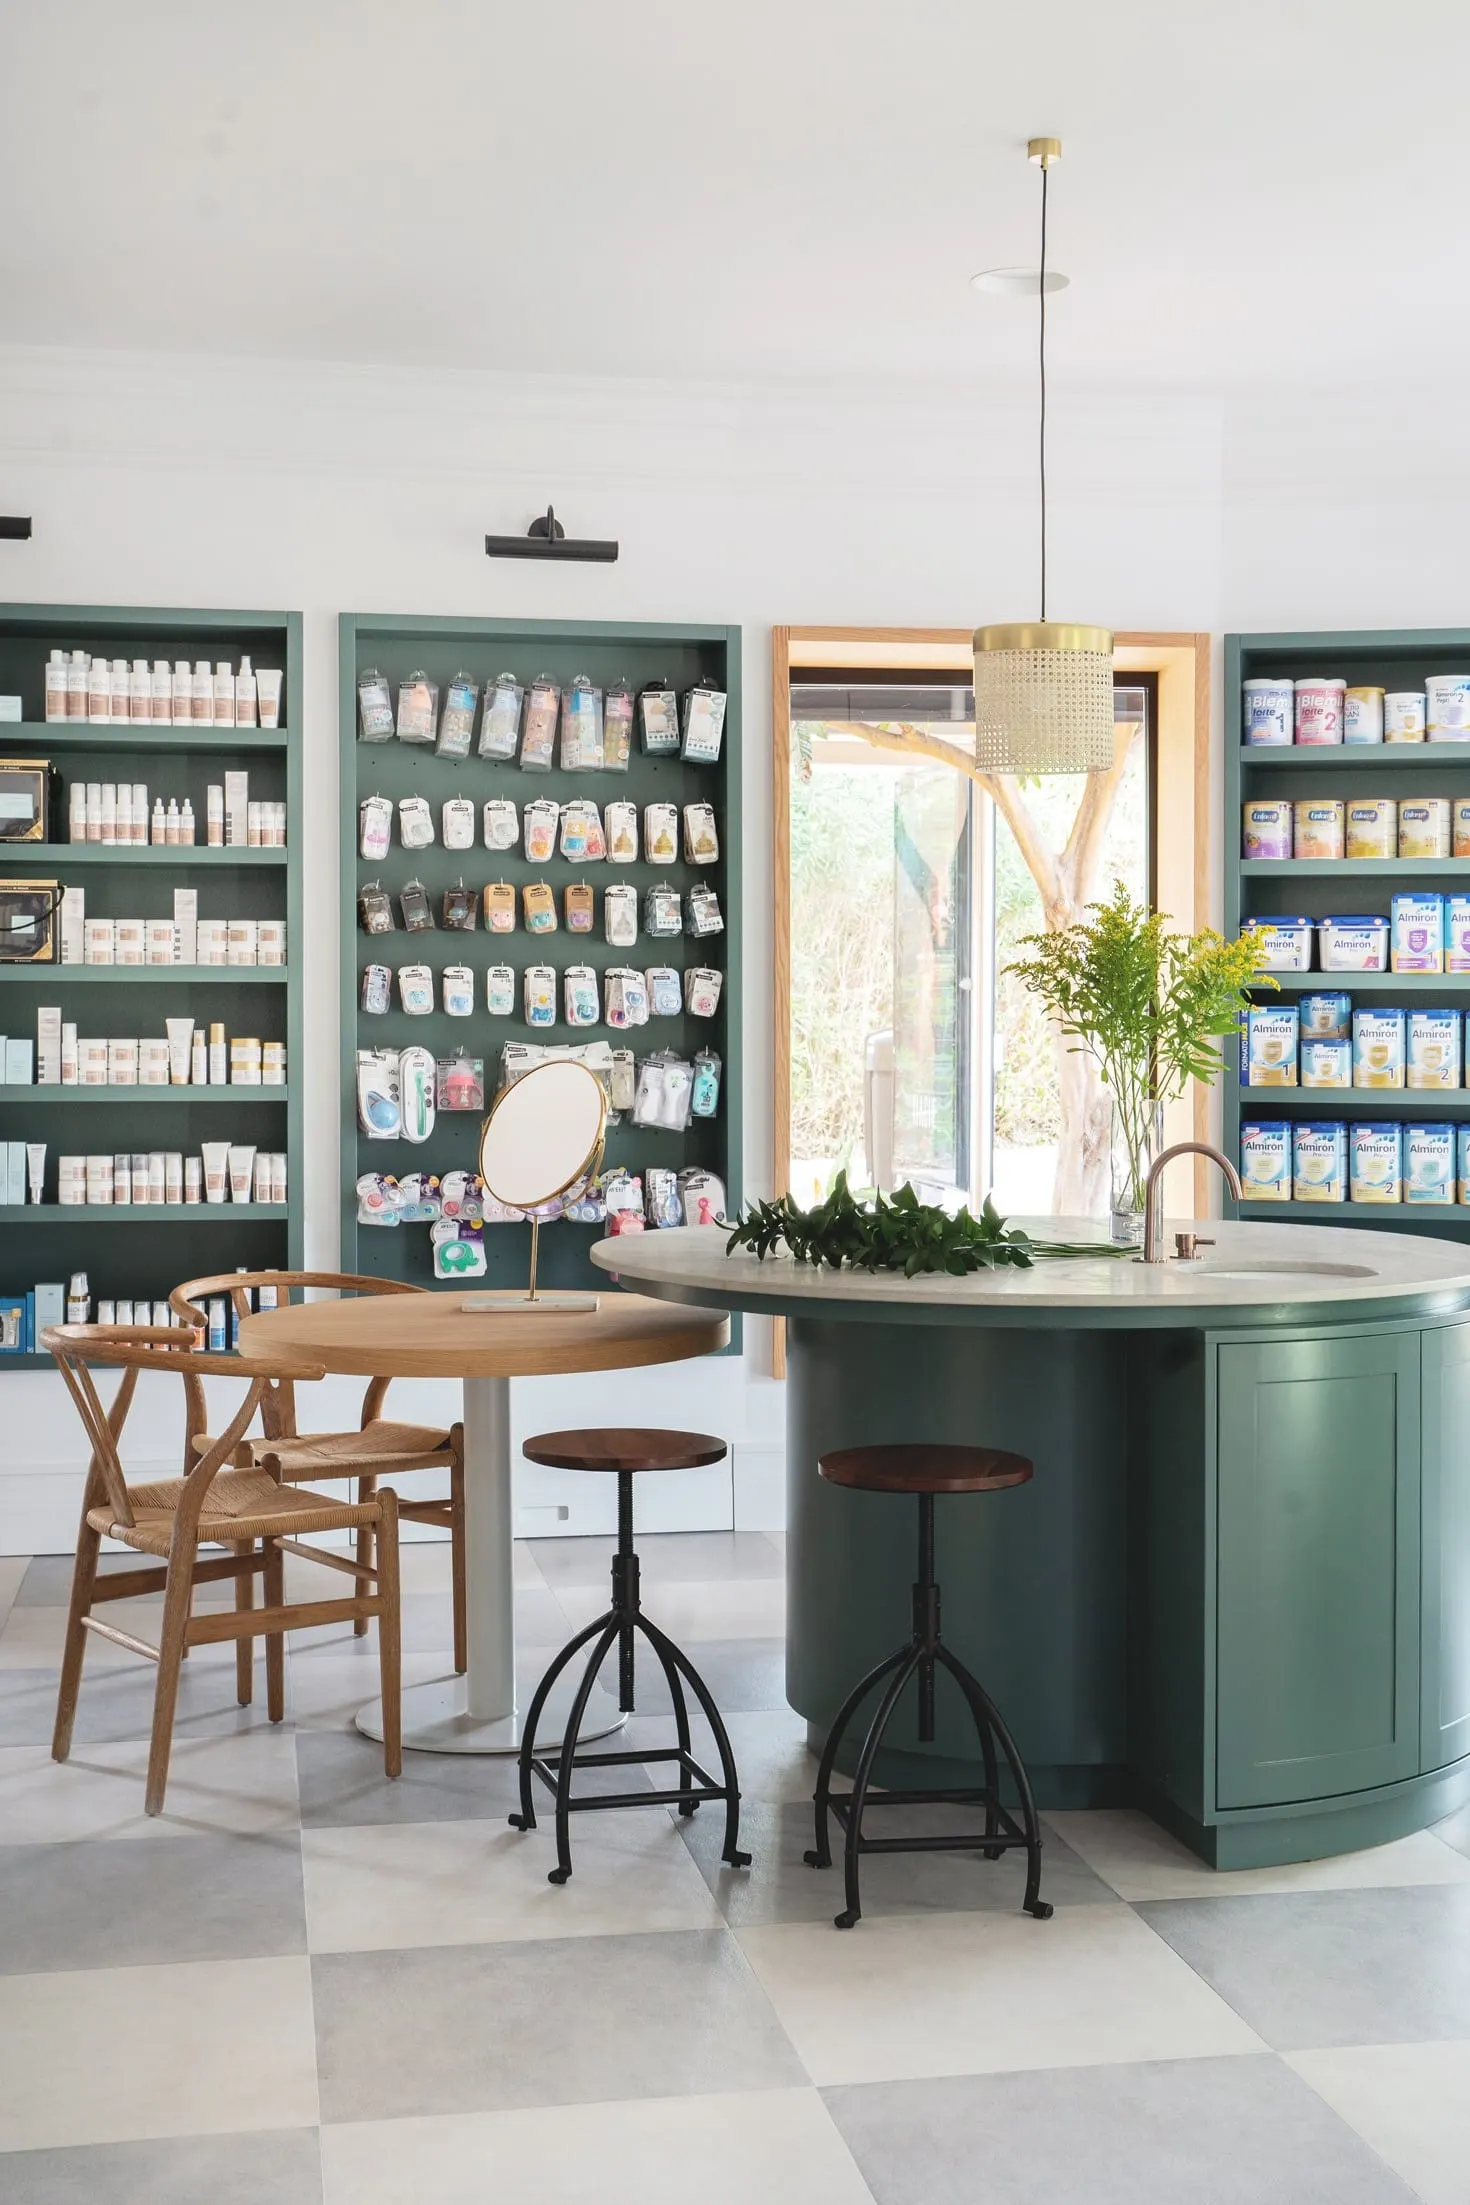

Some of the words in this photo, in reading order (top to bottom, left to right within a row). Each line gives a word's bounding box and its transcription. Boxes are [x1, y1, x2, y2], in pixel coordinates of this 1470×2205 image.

[1458, 693, 1464, 703] 2
[1252, 707, 1276, 716] forte
[1301, 707, 1324, 715] forte
[1324, 712, 1336, 731] 2
[1241, 1040, 1249, 1071] FORMATO
[1282, 1064, 1289, 1076] 1
[1388, 1068, 1394, 1079] 1
[1440, 1068, 1449, 1080] 2
[1274, 1180, 1281, 1192] 1
[1325, 1181, 1332, 1193] 1
[1385, 1182, 1394, 1194] 2
[1439, 1184, 1446, 1195] 1
